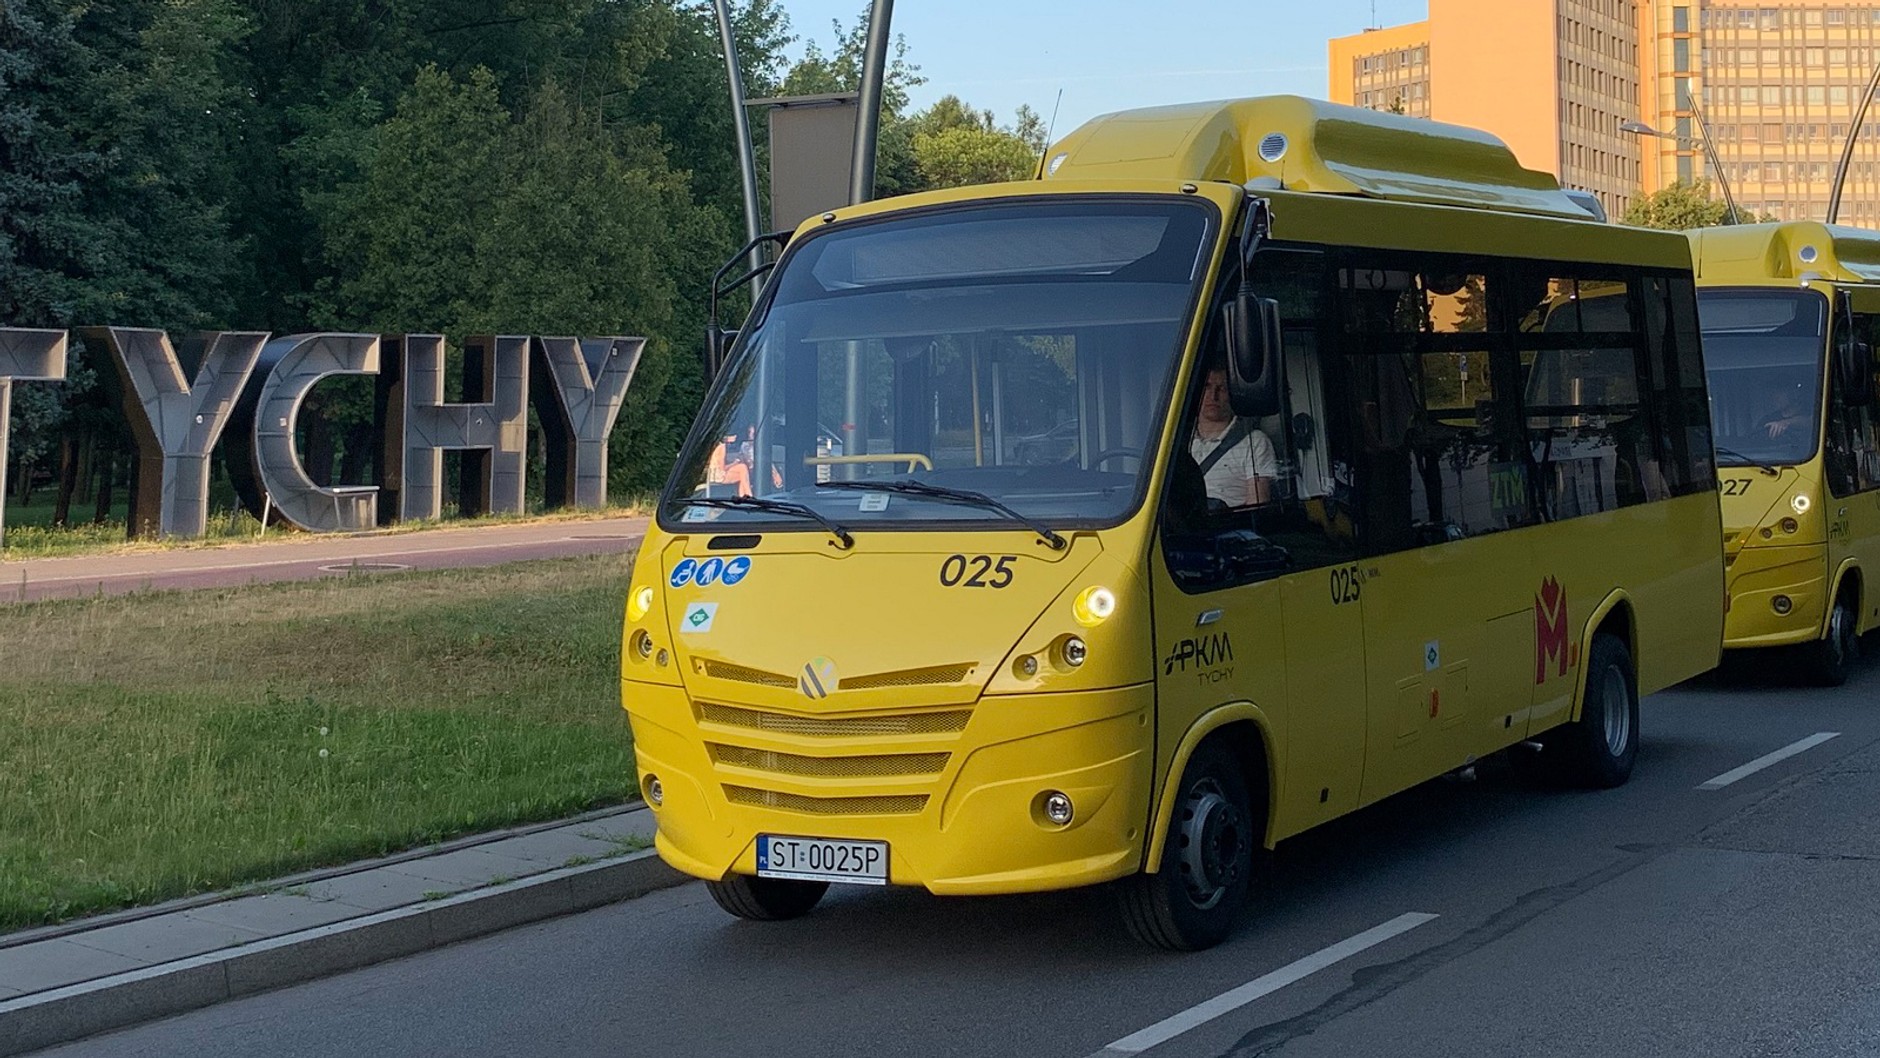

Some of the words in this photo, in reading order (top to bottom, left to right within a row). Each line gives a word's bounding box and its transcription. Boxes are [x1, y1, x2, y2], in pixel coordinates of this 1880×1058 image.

[1719, 479, 1753, 496] 27
[940, 554, 1018, 588] 025
[1331, 566, 1360, 605] 025
[1175, 631, 1233, 672] PKM
[1197, 667, 1234, 686] TYCHY
[772, 841, 800, 868] ST
[809, 843, 880, 874] 0025P
